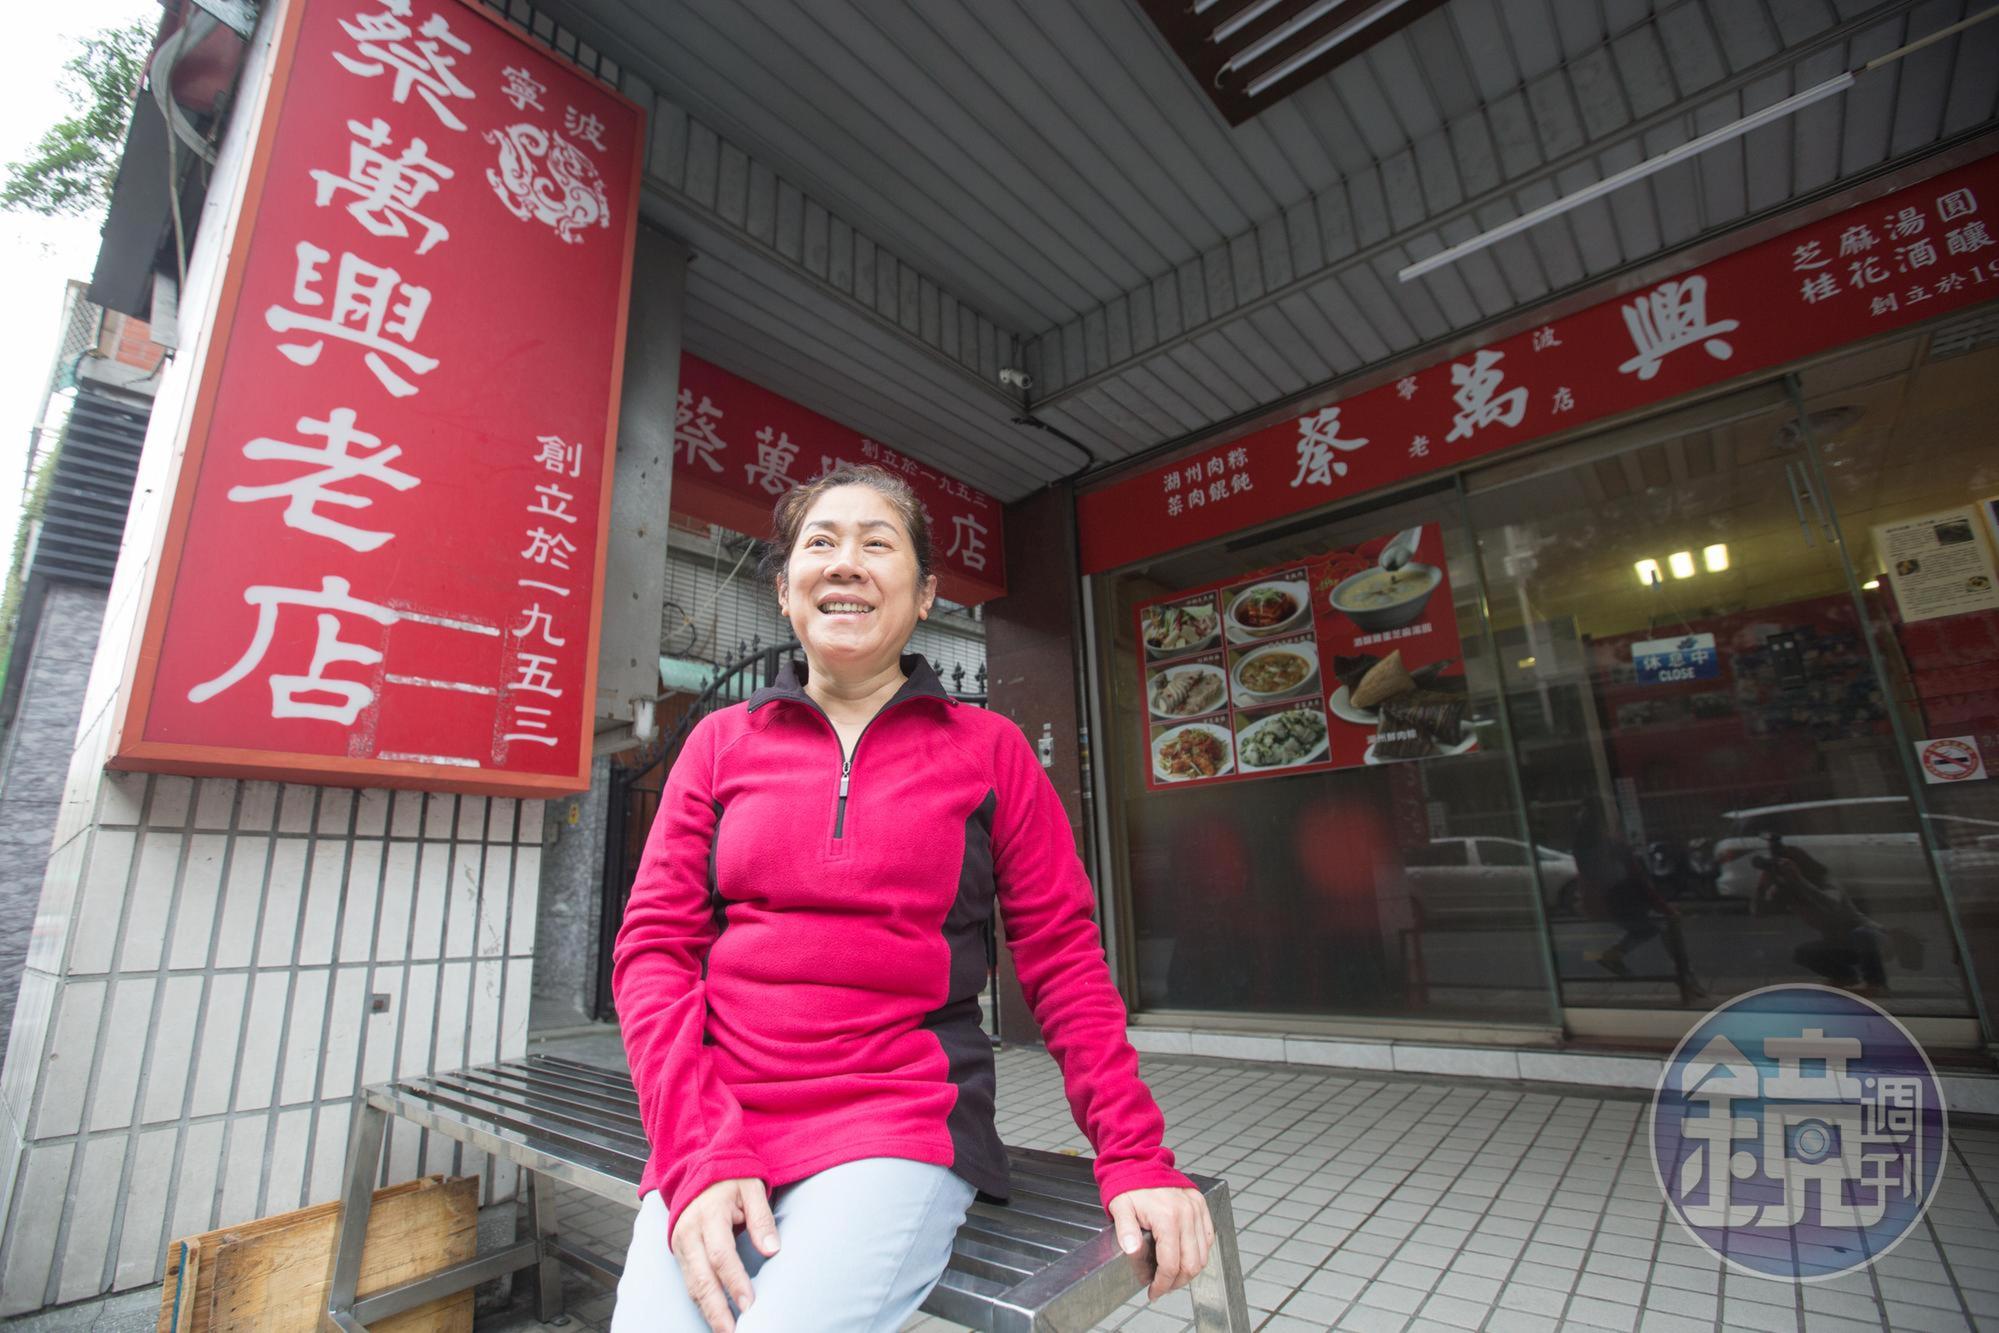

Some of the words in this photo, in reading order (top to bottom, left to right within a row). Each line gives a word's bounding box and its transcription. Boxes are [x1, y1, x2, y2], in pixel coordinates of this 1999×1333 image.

[500, 65, 606, 152] 寧波
[1792, 187, 1978, 272] 芝麻湯圓
[1800, 220, 1996, 304] 桂花酒釀
[187, 0, 476, 726] 蔡萬興老店
[1290, 274, 1740, 488] 蔡萬興
[673, 388, 988, 572] 蔡萬店
[859, 438, 989, 509] 創立於一九五三
[1162, 447, 1249, 494] 湖州肉粽
[1167, 471, 1254, 517] 菜肉餛飩
[502, 434, 583, 748] 創立於一九五三
[1643, 650, 1709, 671] 休息中
[1658, 667, 1696, 682] CLOSE
